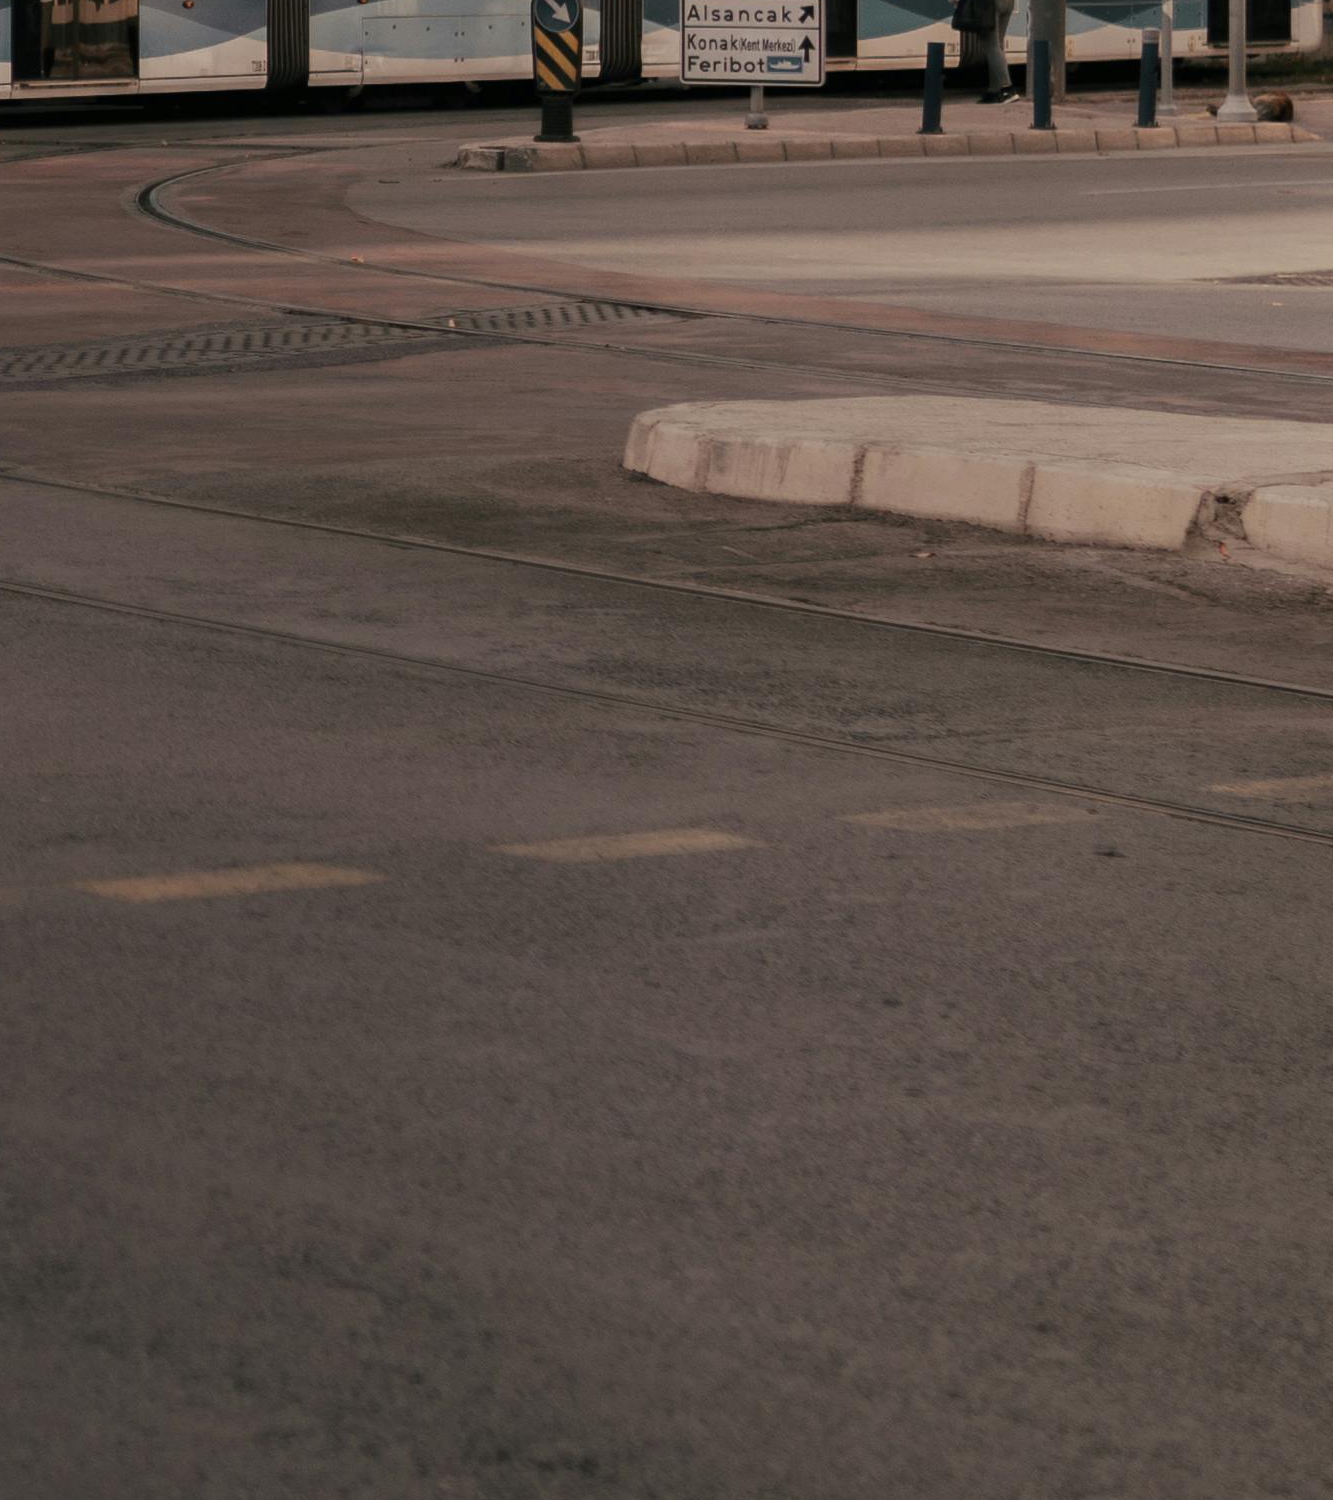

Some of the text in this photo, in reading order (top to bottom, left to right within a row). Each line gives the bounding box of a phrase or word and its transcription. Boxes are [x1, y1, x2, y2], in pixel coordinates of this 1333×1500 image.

[687, 3, 792, 23] Alsancak
[687, 33, 738, 51] Konak
[687, 56, 765, 74] Feribot
